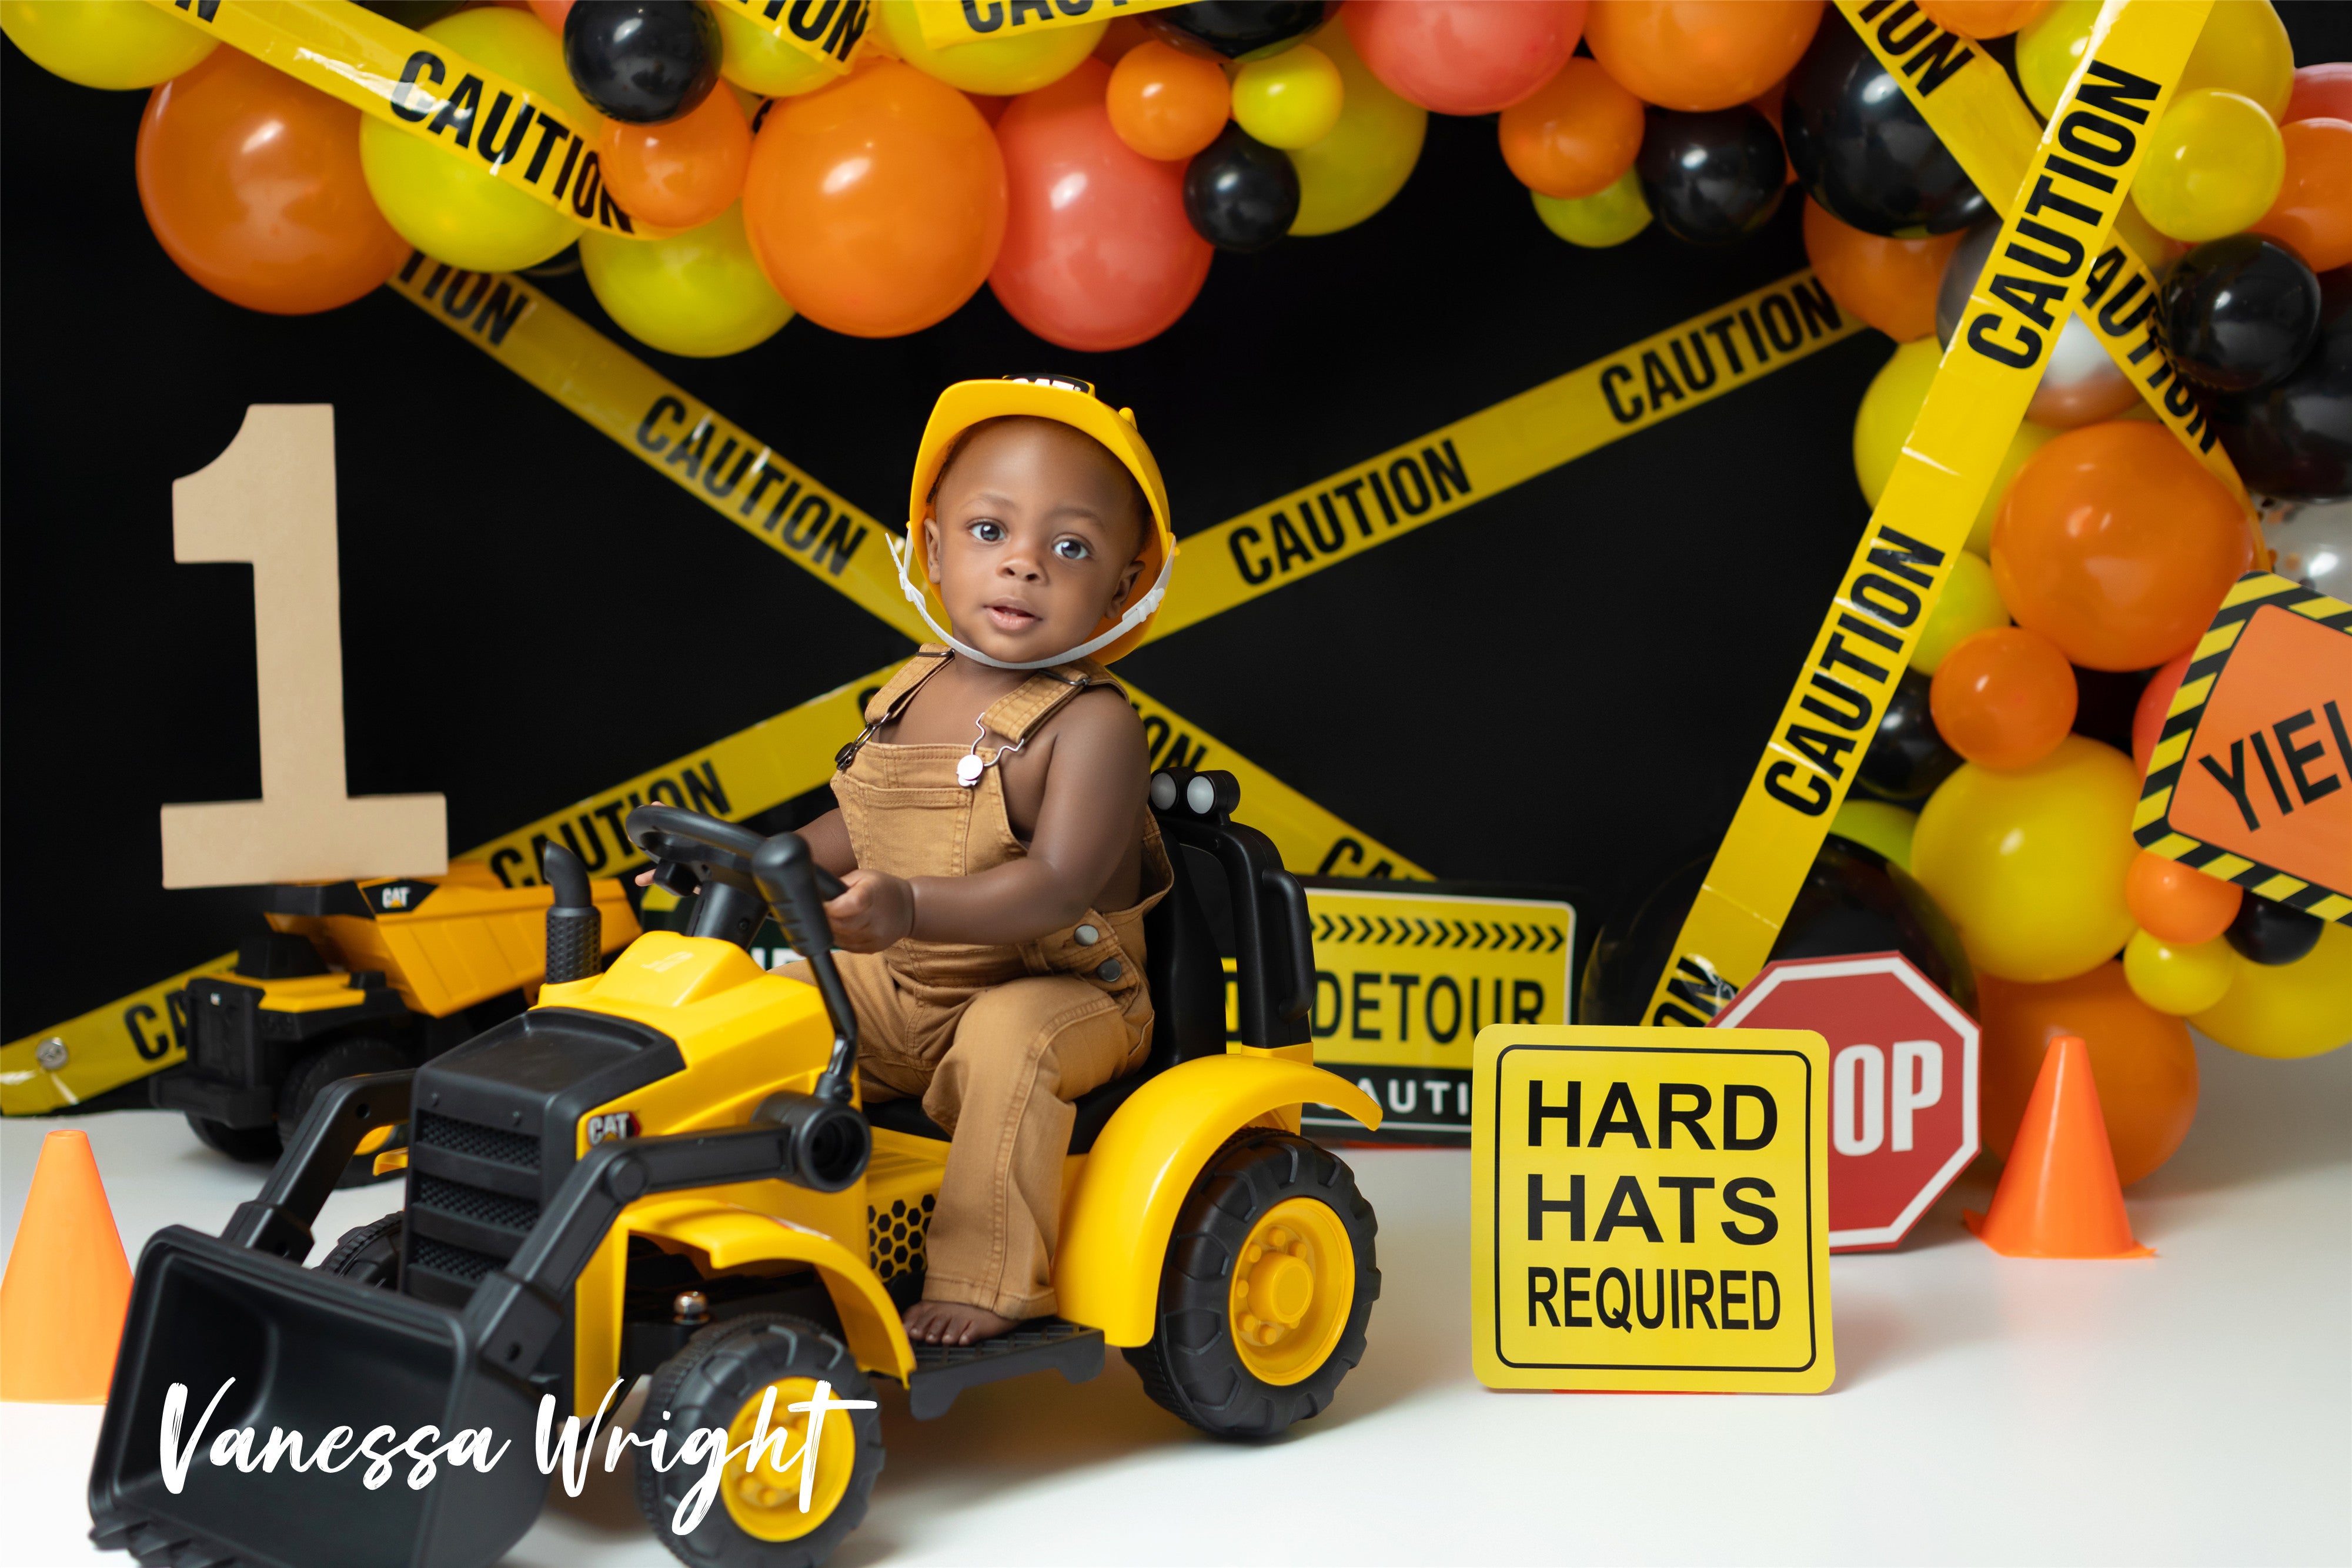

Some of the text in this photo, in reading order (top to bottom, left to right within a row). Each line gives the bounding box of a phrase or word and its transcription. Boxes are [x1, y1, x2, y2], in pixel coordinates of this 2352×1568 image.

[1967, 59, 2162, 370] CAUTION
[1599, 275, 1843, 424] CAUTION
[2082, 245, 2218, 454] AUTIO
[636, 394, 868, 577] CAUTION
[1228, 438, 1472, 586] CAUTION
[1764, 525, 1946, 817] CAUTION
[382, 886, 410, 909] CAT
[1312, 970, 1545, 1043] DETOUR
[589, 1112, 629, 1145] CAT
[1528, 1079, 1778, 1151] HARD
[1833, 1039, 1943, 1156] OP
[1528, 1174, 1779, 1245] HATS
[1528, 1266, 1780, 1333] REQUIRED
